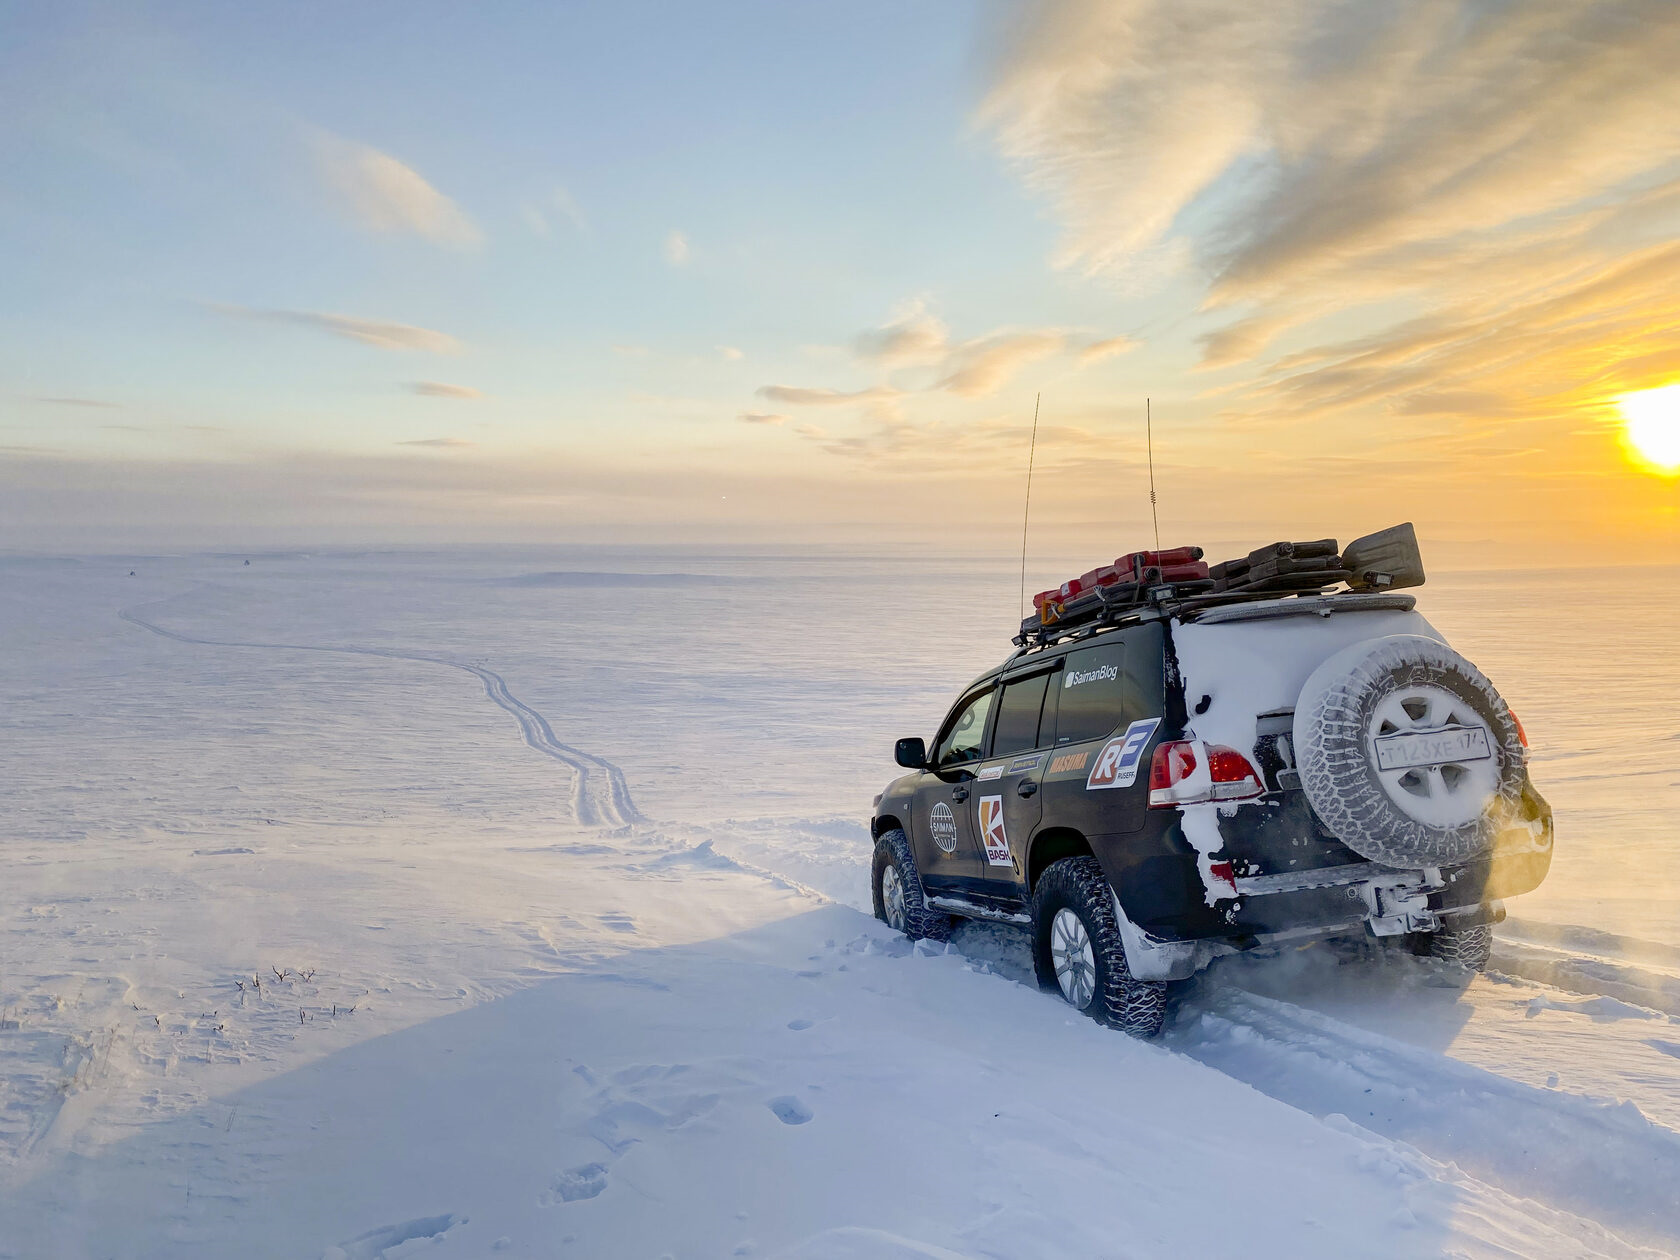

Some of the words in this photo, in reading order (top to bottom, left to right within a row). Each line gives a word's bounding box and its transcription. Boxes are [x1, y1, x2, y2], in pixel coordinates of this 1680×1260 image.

[1074, 665, 1118, 686] SaimanBlog
[1049, 752, 1089, 774] MASUMA
[932, 822, 954, 833] SAIMAN
[988, 849, 1011, 861] BASK
